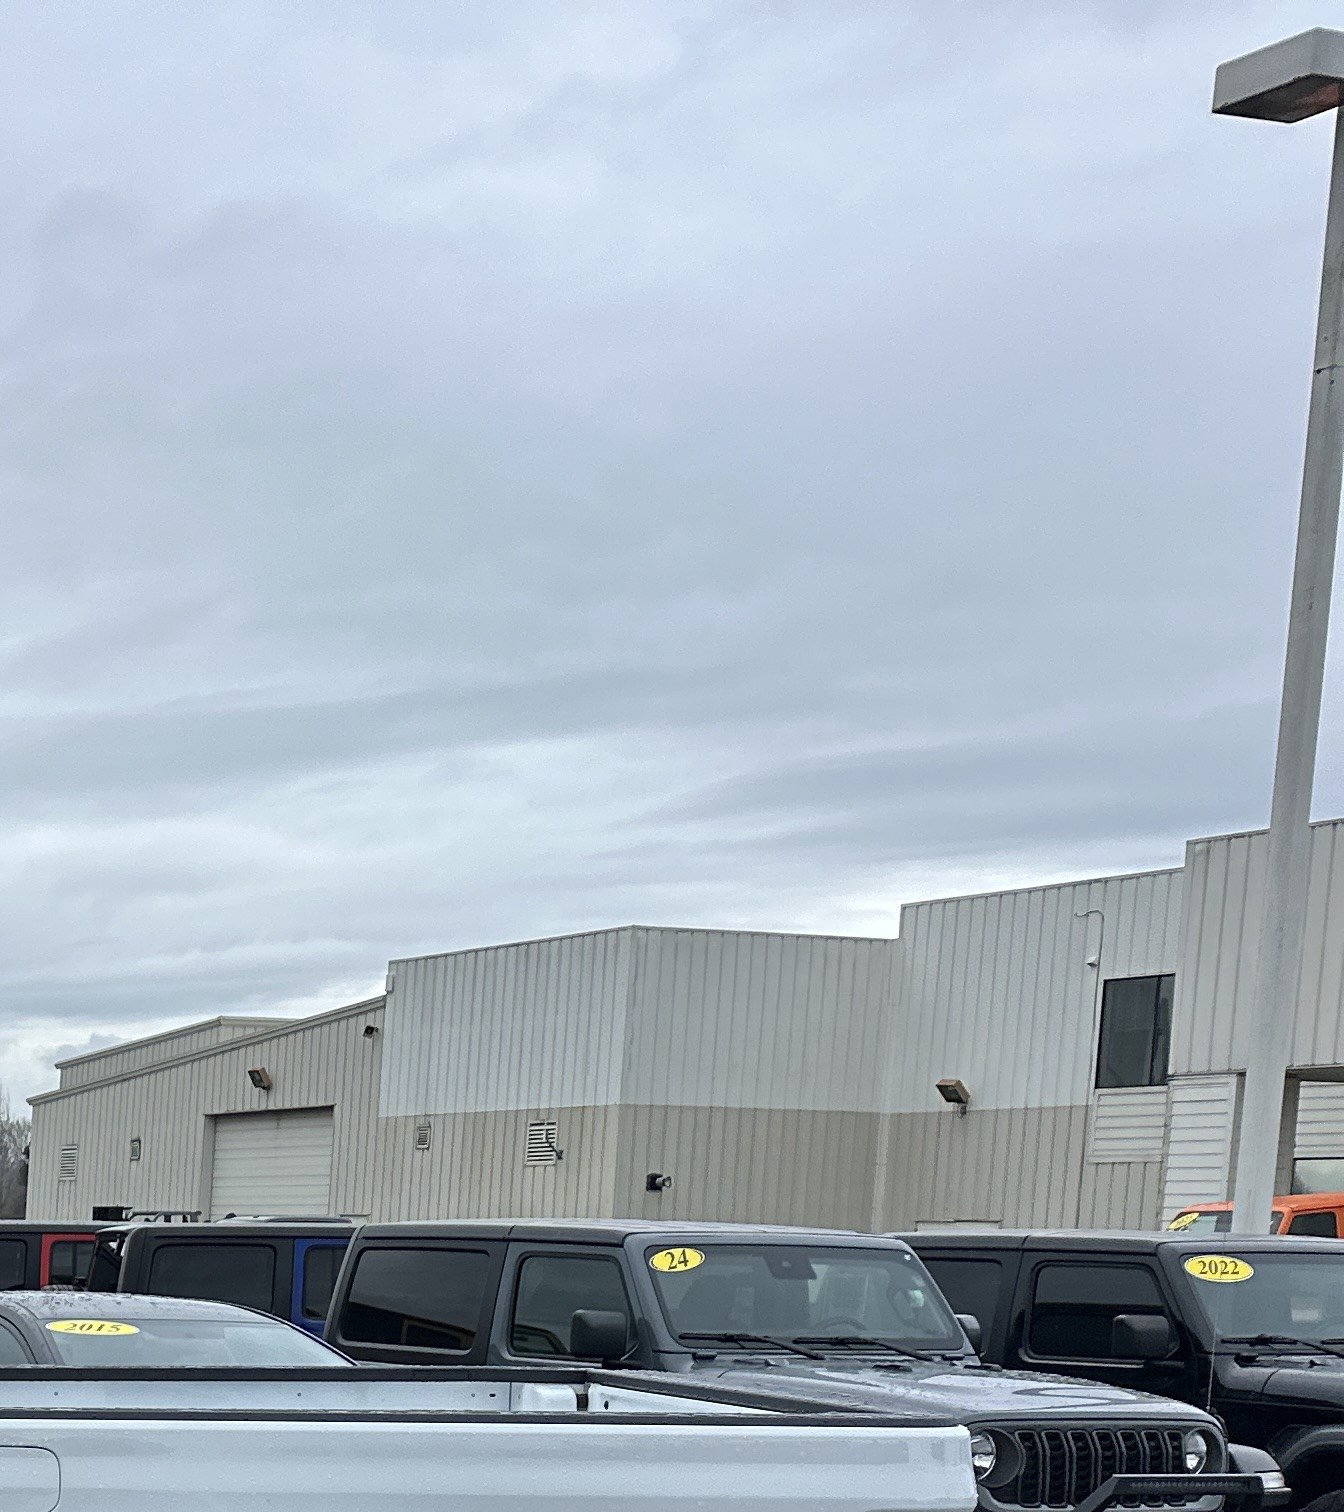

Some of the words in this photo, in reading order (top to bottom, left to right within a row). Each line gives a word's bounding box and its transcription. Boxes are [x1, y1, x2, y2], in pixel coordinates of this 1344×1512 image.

[664, 1248, 689, 1270] 24
[1197, 1260, 1240, 1275] 2022
[63, 1322, 122, 1332] 2015
